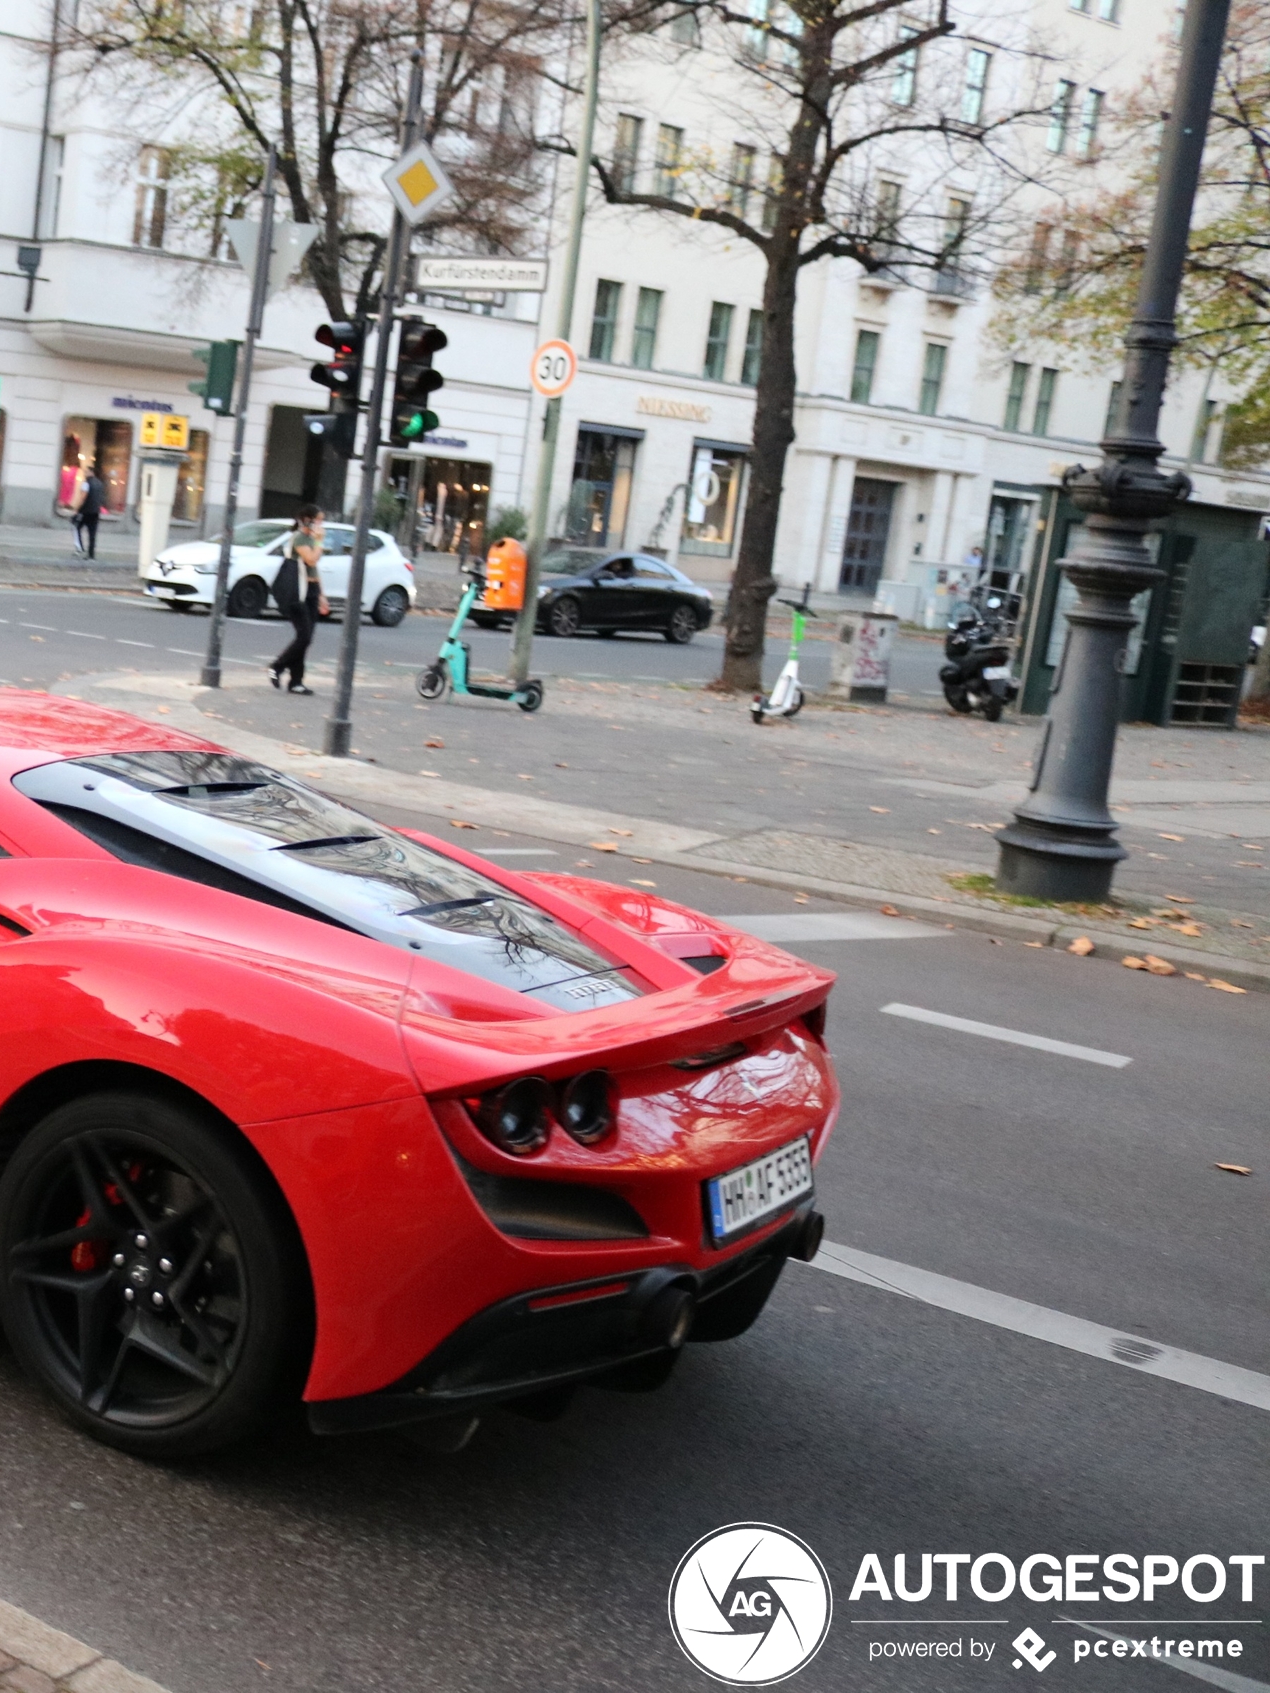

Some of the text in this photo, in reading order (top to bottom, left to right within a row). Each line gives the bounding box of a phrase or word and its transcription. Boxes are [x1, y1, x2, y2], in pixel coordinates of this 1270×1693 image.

[422, 262, 540, 282] Kurfürstendamm
[539, 355, 567, 381] 30
[636, 396, 713, 424] NIESSING
[720, 1176, 747, 1226] HH
[756, 1162, 773, 1209] AF
